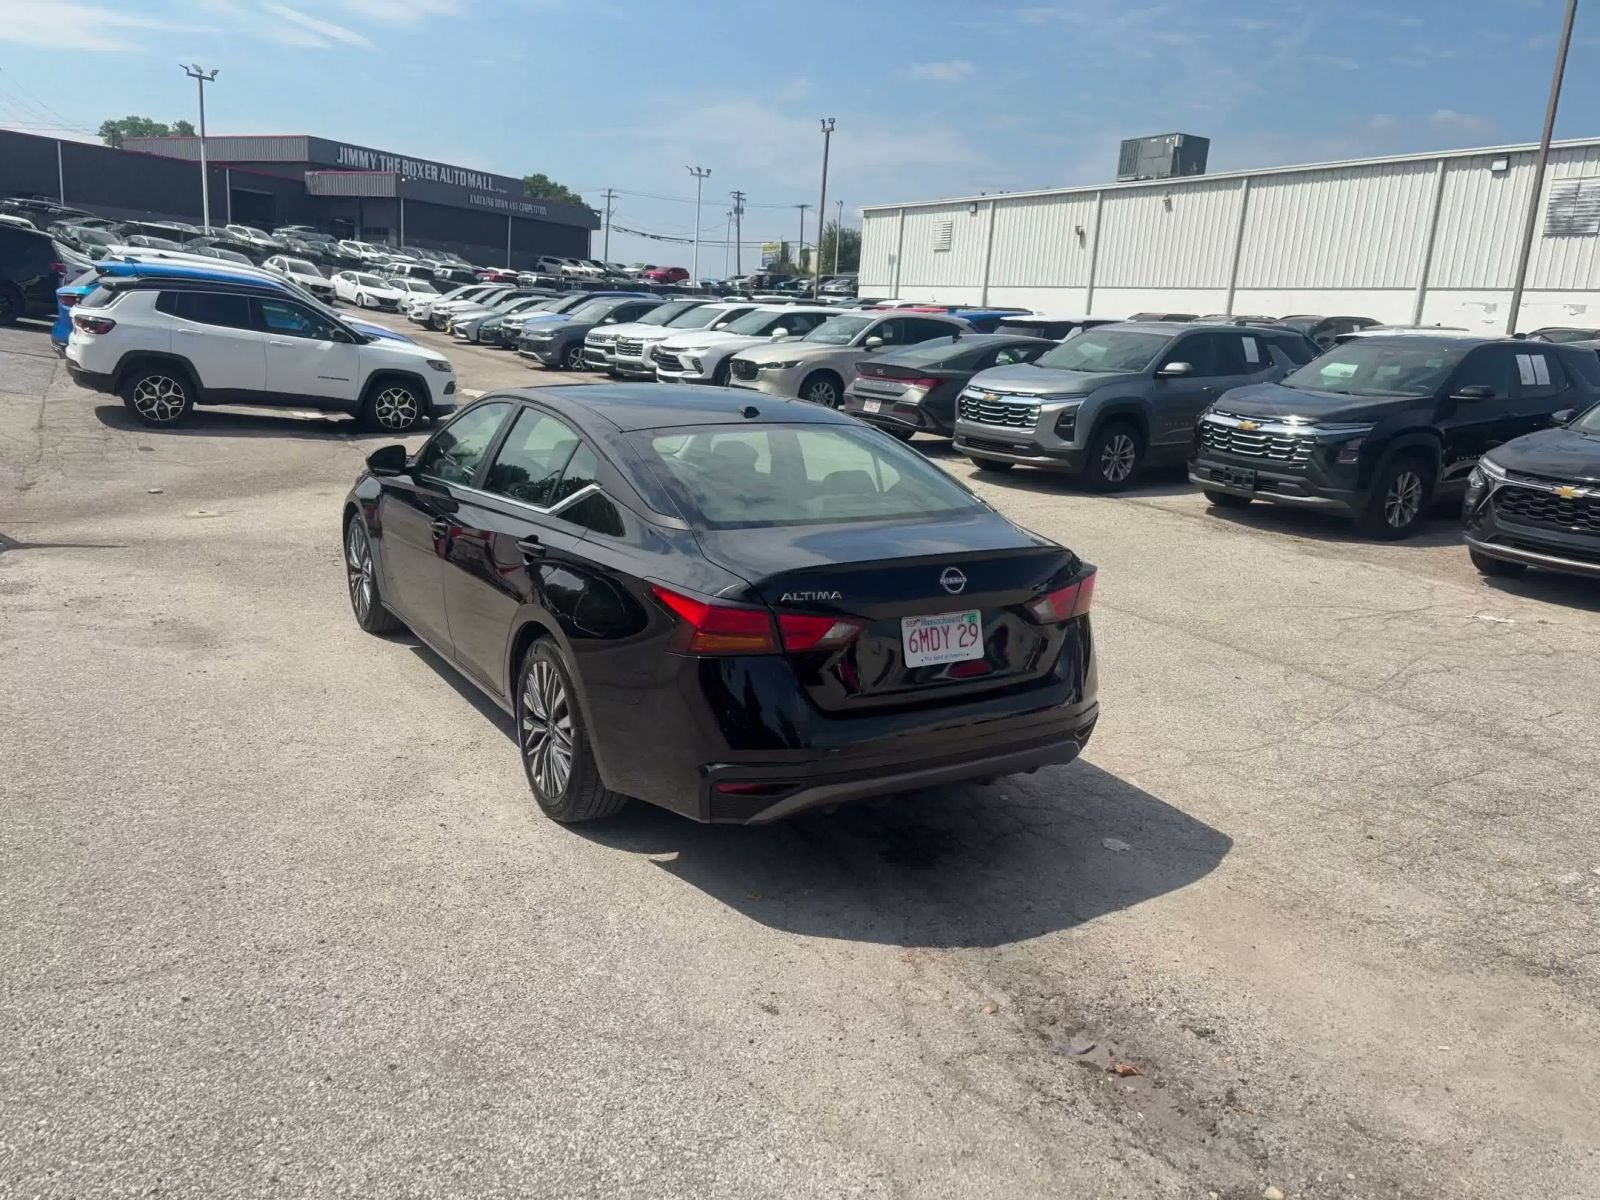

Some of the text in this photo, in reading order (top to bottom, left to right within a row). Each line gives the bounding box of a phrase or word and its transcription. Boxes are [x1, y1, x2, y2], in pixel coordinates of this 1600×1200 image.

[337, 146, 377, 170] JIMMY
[379, 154, 401, 174] THE
[402, 159, 438, 182] BOXER
[780, 591, 842, 602] ALTIMA
[908, 623, 979, 654] 6MDY 29
